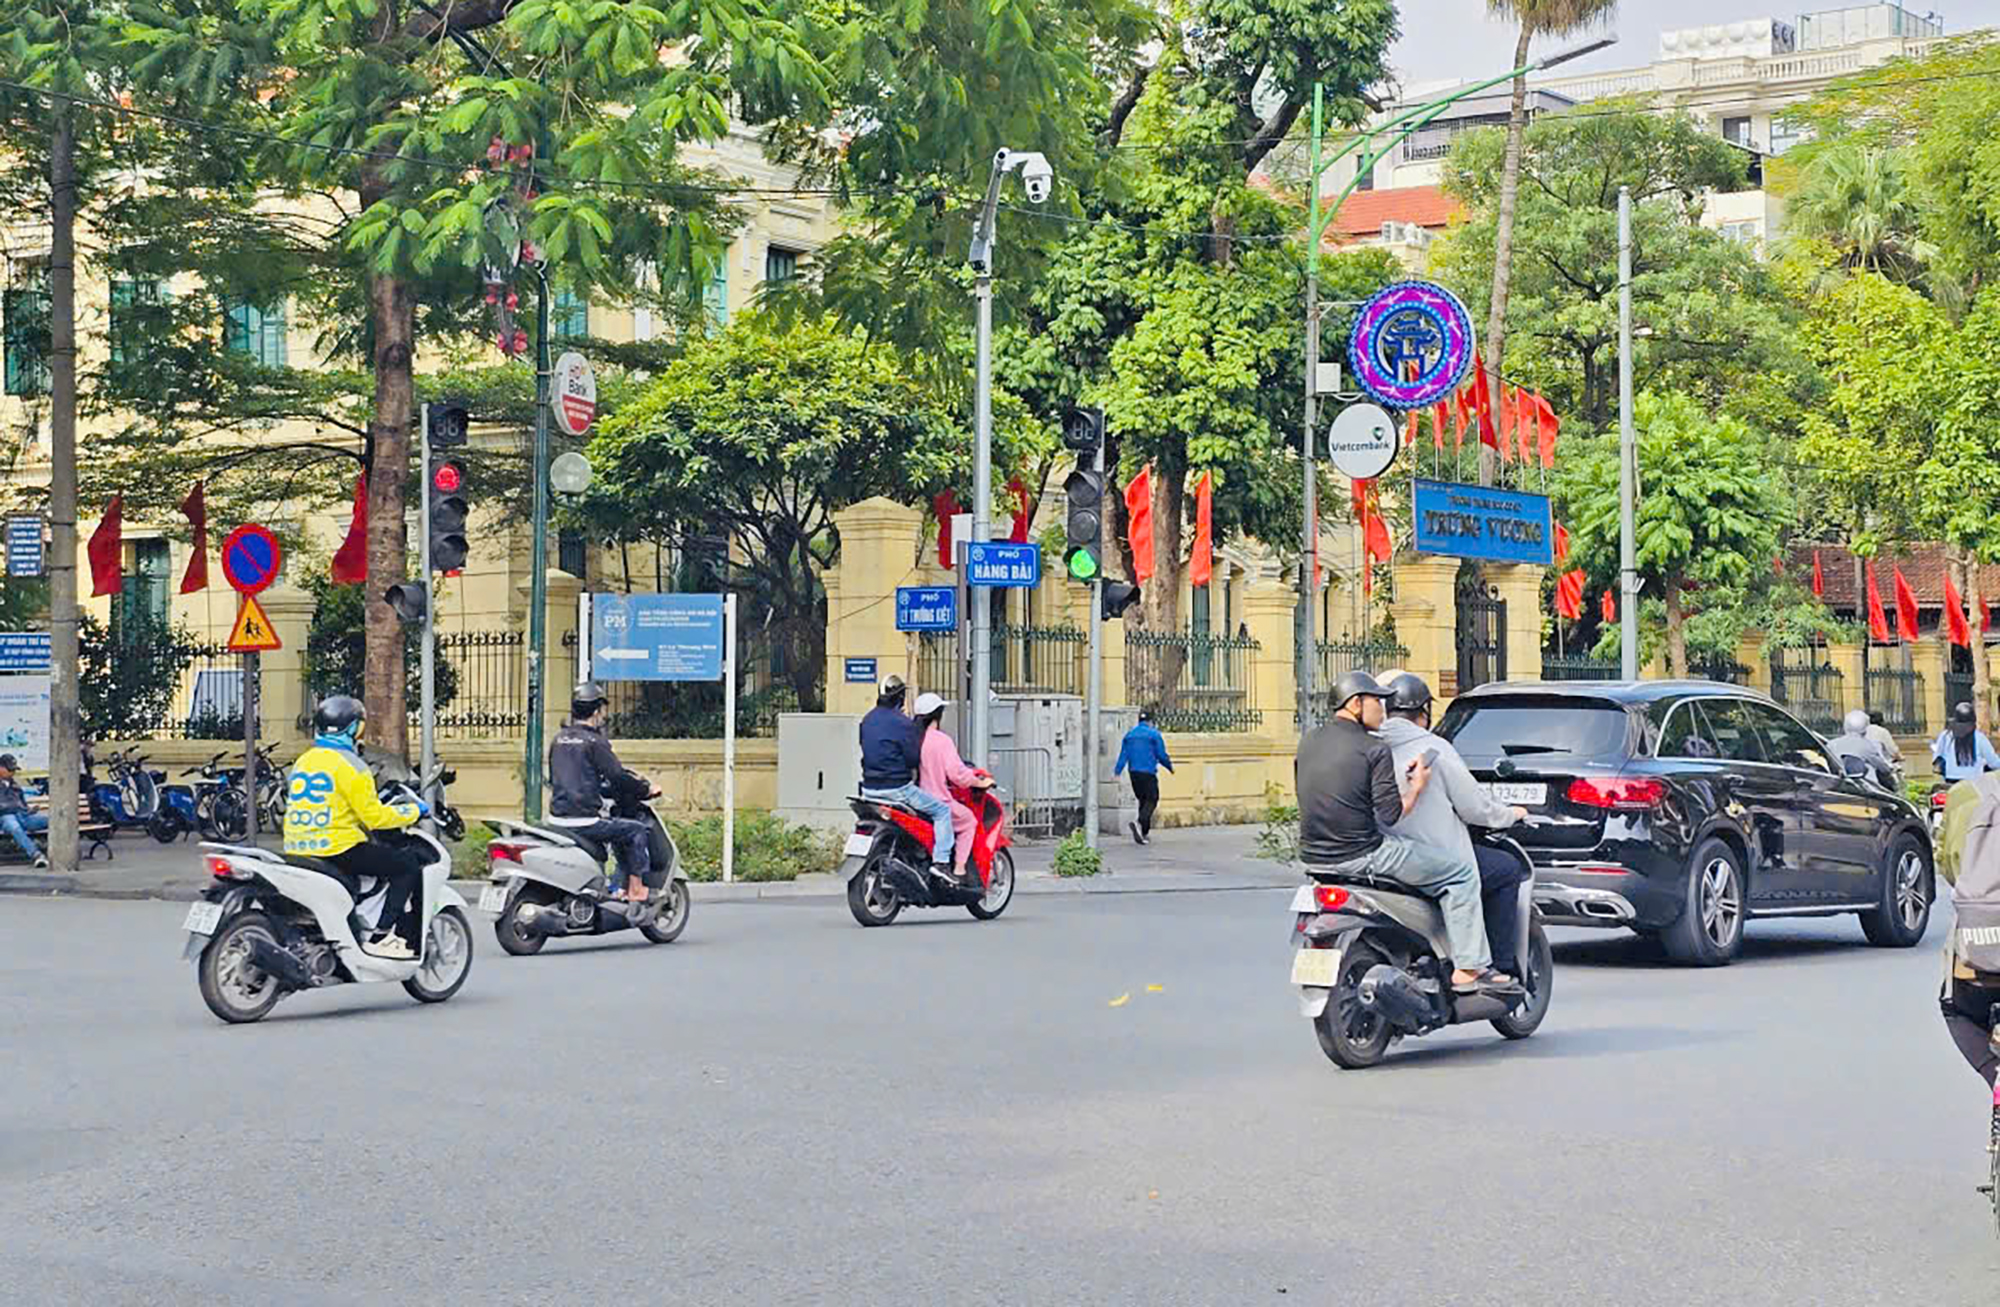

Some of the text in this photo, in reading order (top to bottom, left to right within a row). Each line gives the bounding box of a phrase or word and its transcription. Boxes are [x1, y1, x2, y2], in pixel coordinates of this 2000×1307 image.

[1331, 441, 1390, 452] Vietcombank
[974, 560, 1032, 580] HÀNG BÀI
[604, 615, 627, 628] PM
[288, 807, 331, 828] ood
